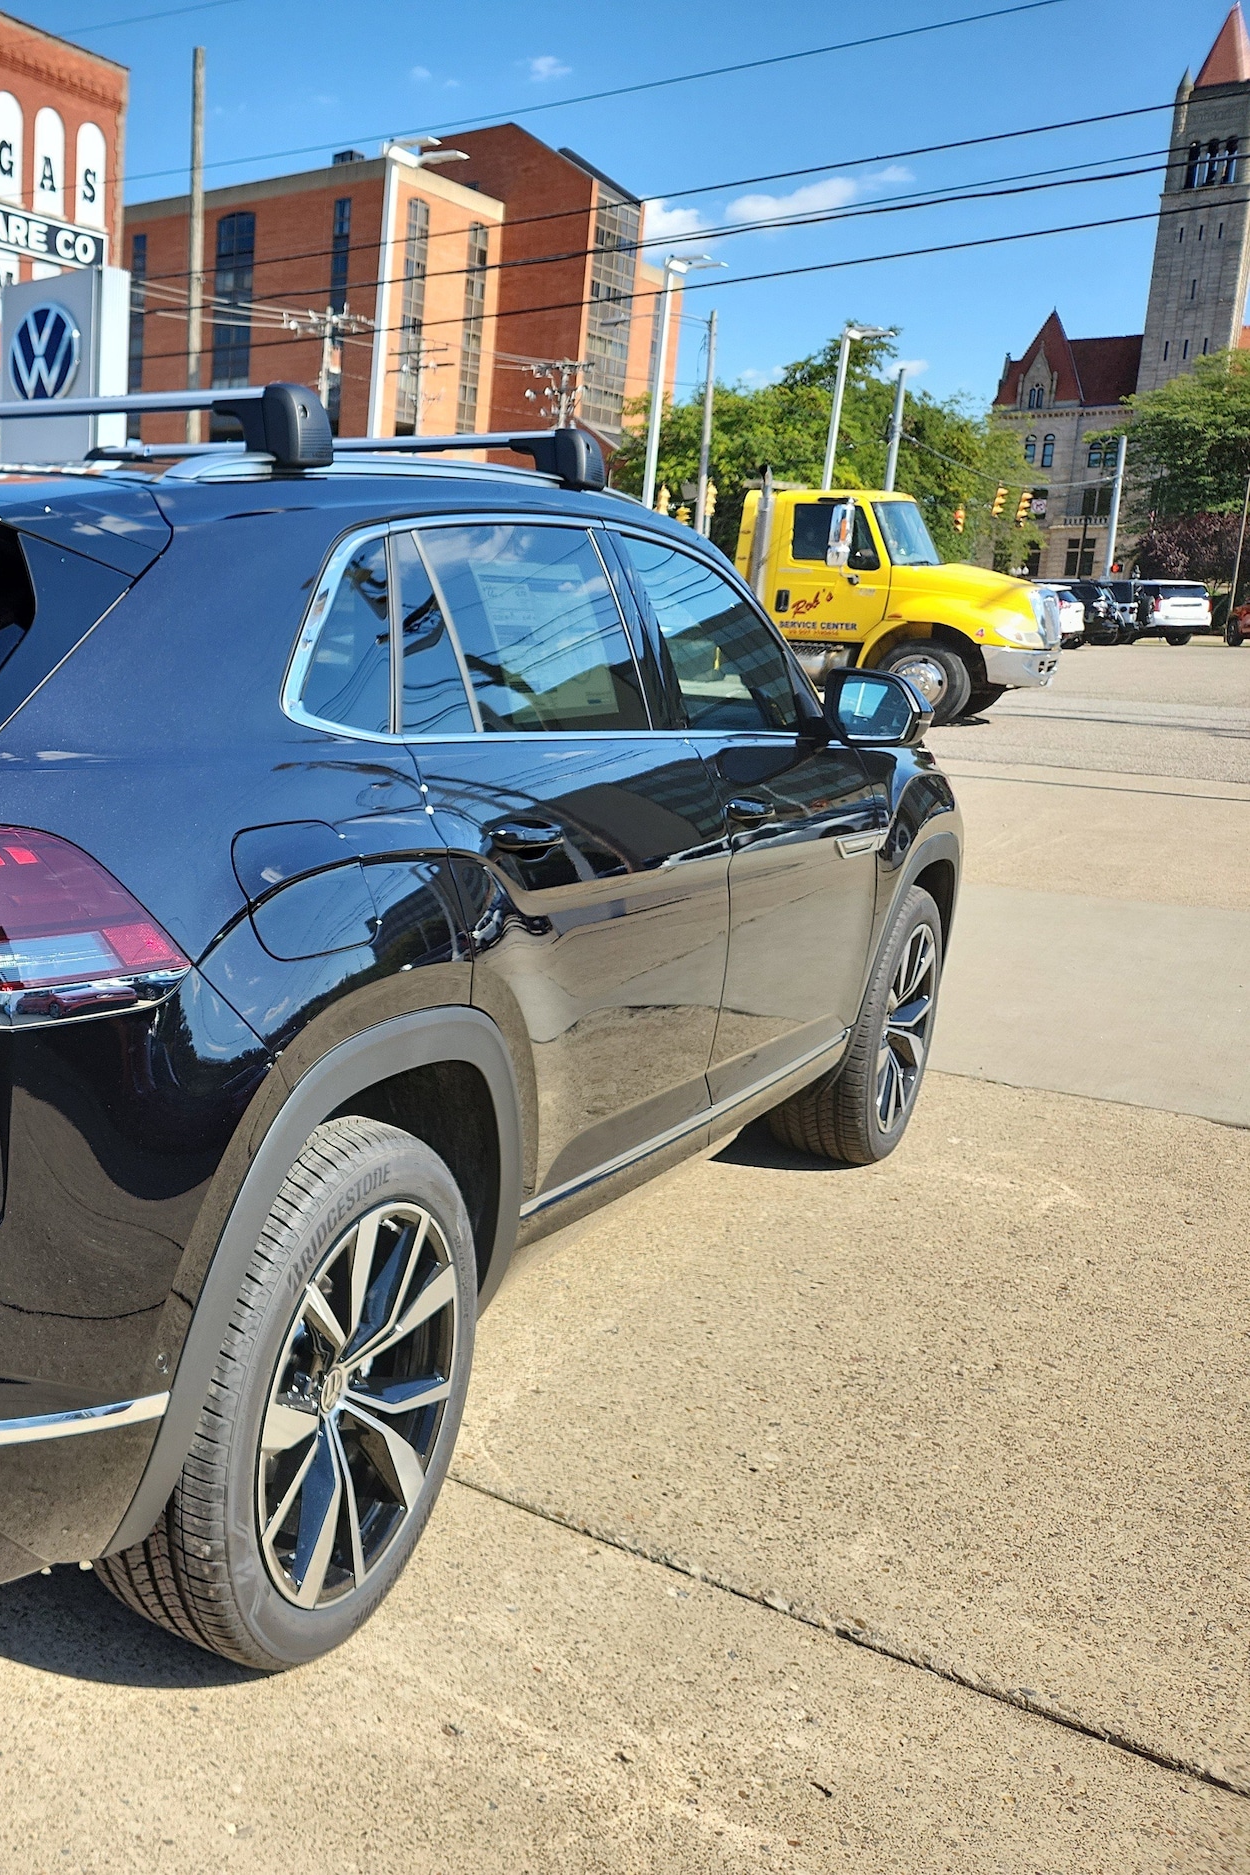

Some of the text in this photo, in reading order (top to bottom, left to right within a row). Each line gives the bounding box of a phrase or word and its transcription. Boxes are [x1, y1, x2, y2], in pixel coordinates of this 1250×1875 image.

[55, 230, 97, 264] CO
[791, 588, 833, 619] Rob's
[778, 620, 857, 631] SERVICE CENTER
[288, 1162, 392, 1297] BRIDGESTONE
